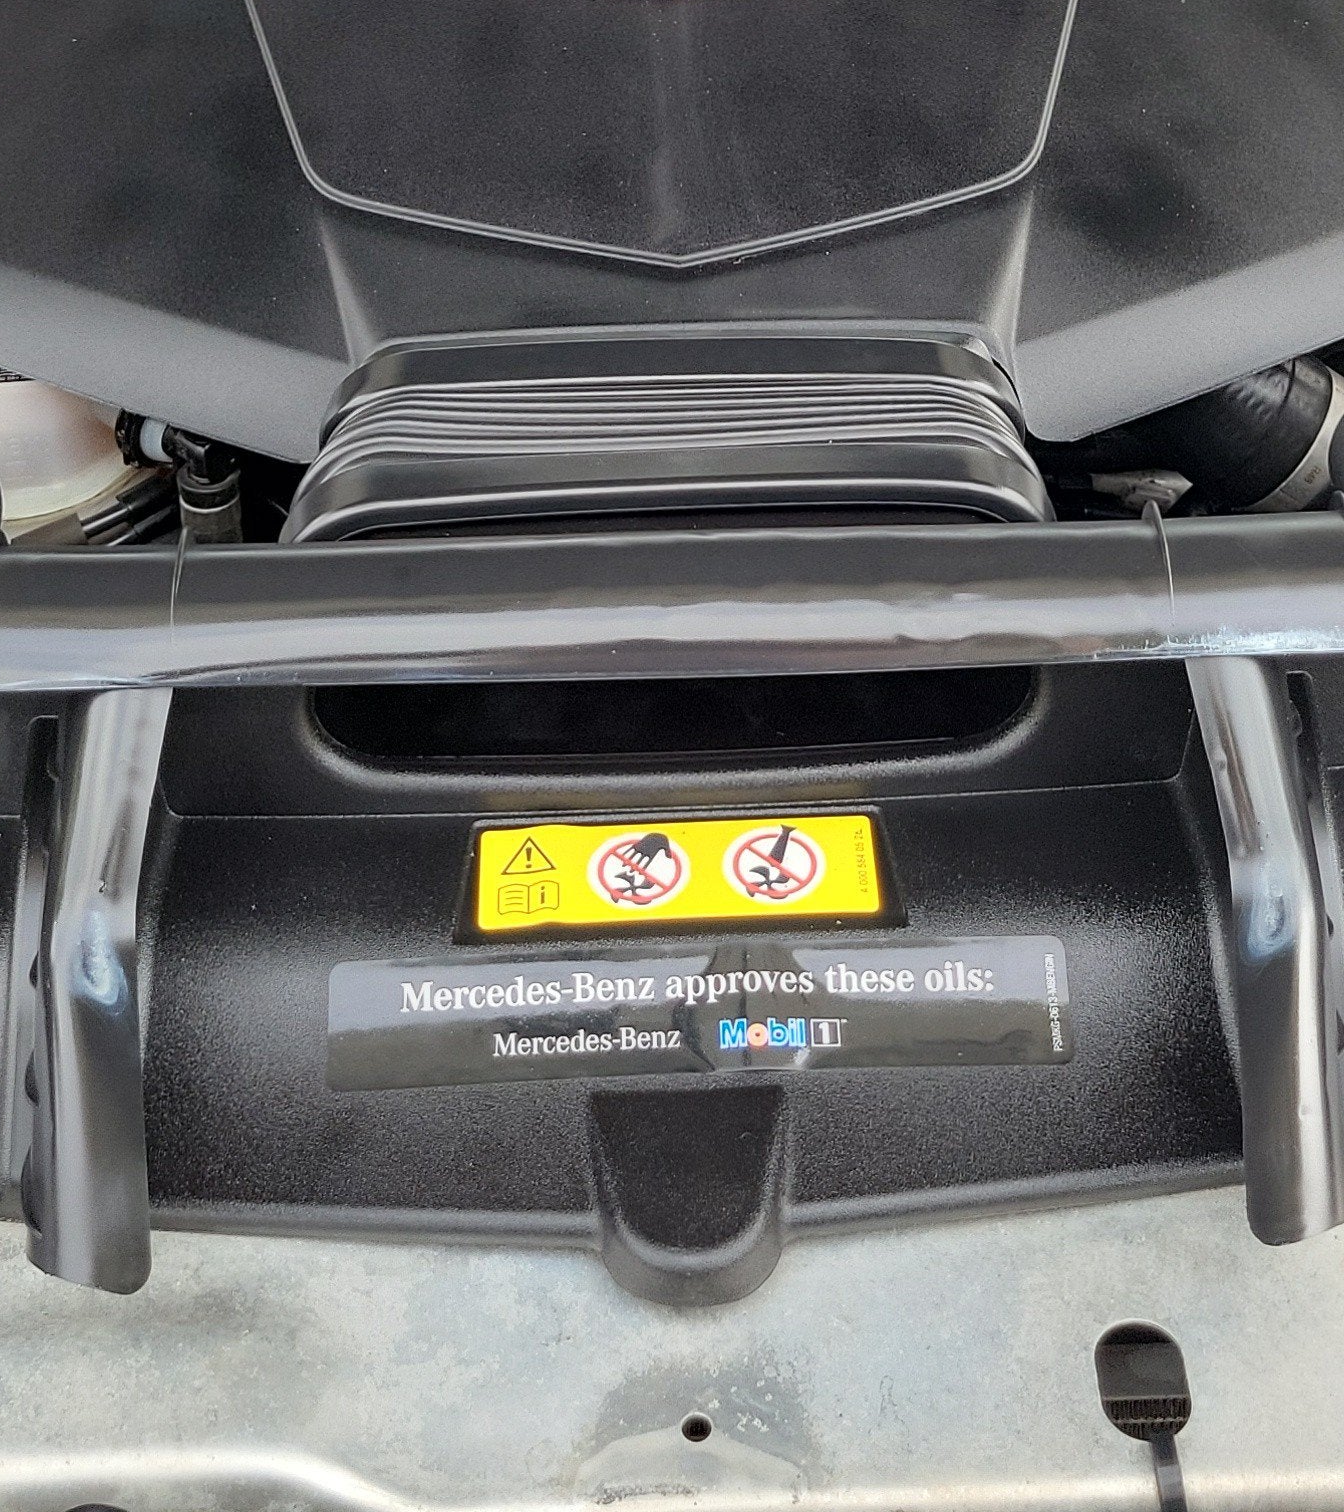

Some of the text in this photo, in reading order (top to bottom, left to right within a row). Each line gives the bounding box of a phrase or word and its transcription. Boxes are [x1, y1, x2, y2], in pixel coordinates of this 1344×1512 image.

[400, 960, 995, 1013] Mercedes-Benz approves these oils:
[492, 1026, 681, 1057] Mercedes-Benz
[719, 1017, 806, 1049] Mobil
